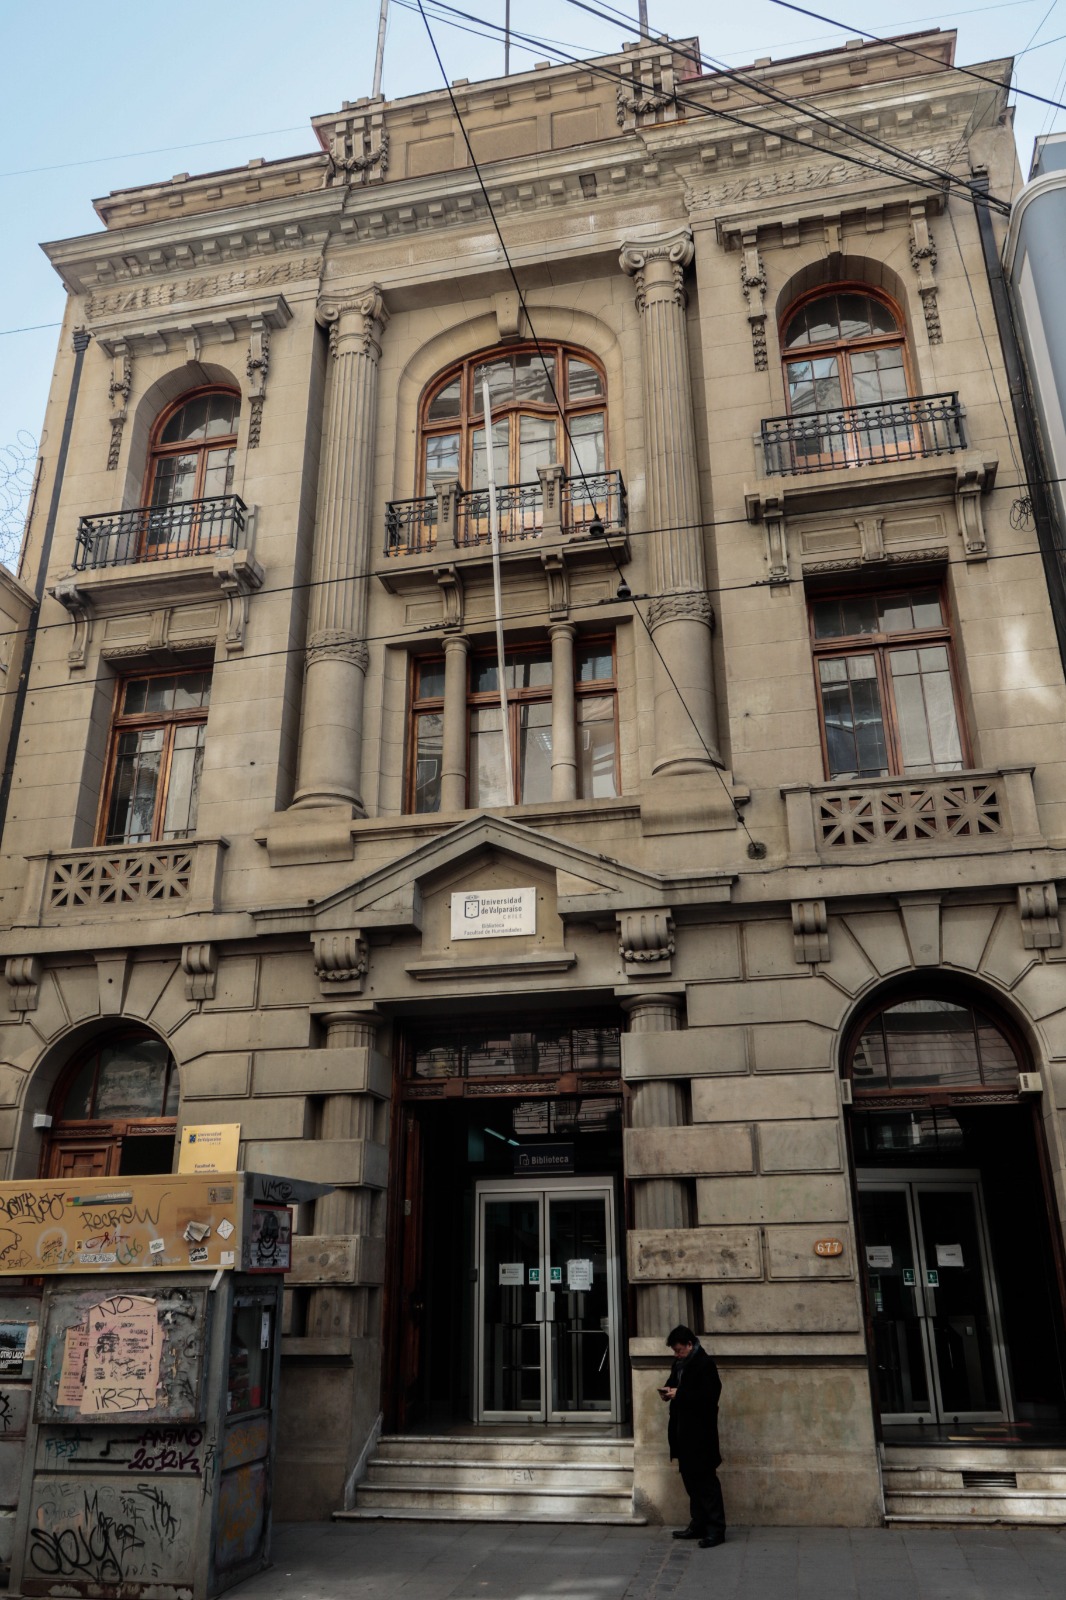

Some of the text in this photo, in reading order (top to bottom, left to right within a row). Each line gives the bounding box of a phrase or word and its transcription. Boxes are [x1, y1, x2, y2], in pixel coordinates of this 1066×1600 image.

[482, 896, 522, 905] Universidad
[481, 905, 522, 915] de Valparaíso
[531, 1156, 569, 1165] Biblioteca
[817, 1242, 839, 1253] 677
